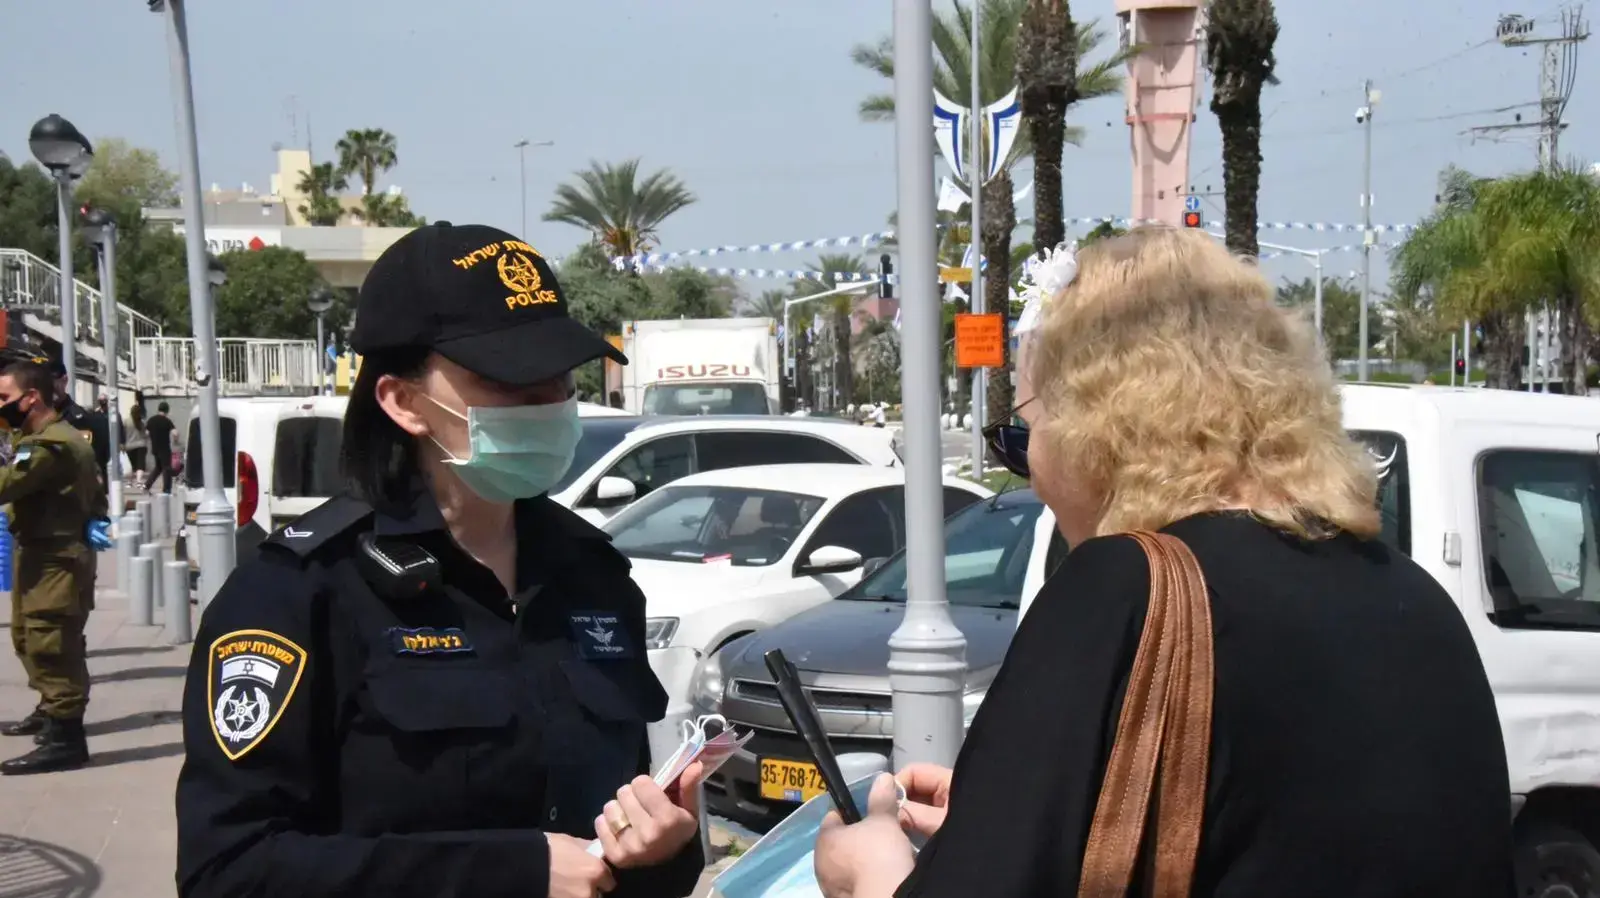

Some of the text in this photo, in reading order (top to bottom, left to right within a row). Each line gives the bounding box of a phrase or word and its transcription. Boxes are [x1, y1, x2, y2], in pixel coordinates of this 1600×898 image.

[452, 242, 500, 269] ישראל
[505, 290, 558, 310] POLICE
[658, 364, 750, 379] ISUZU
[217, 641, 295, 664] משטרת ישראל
